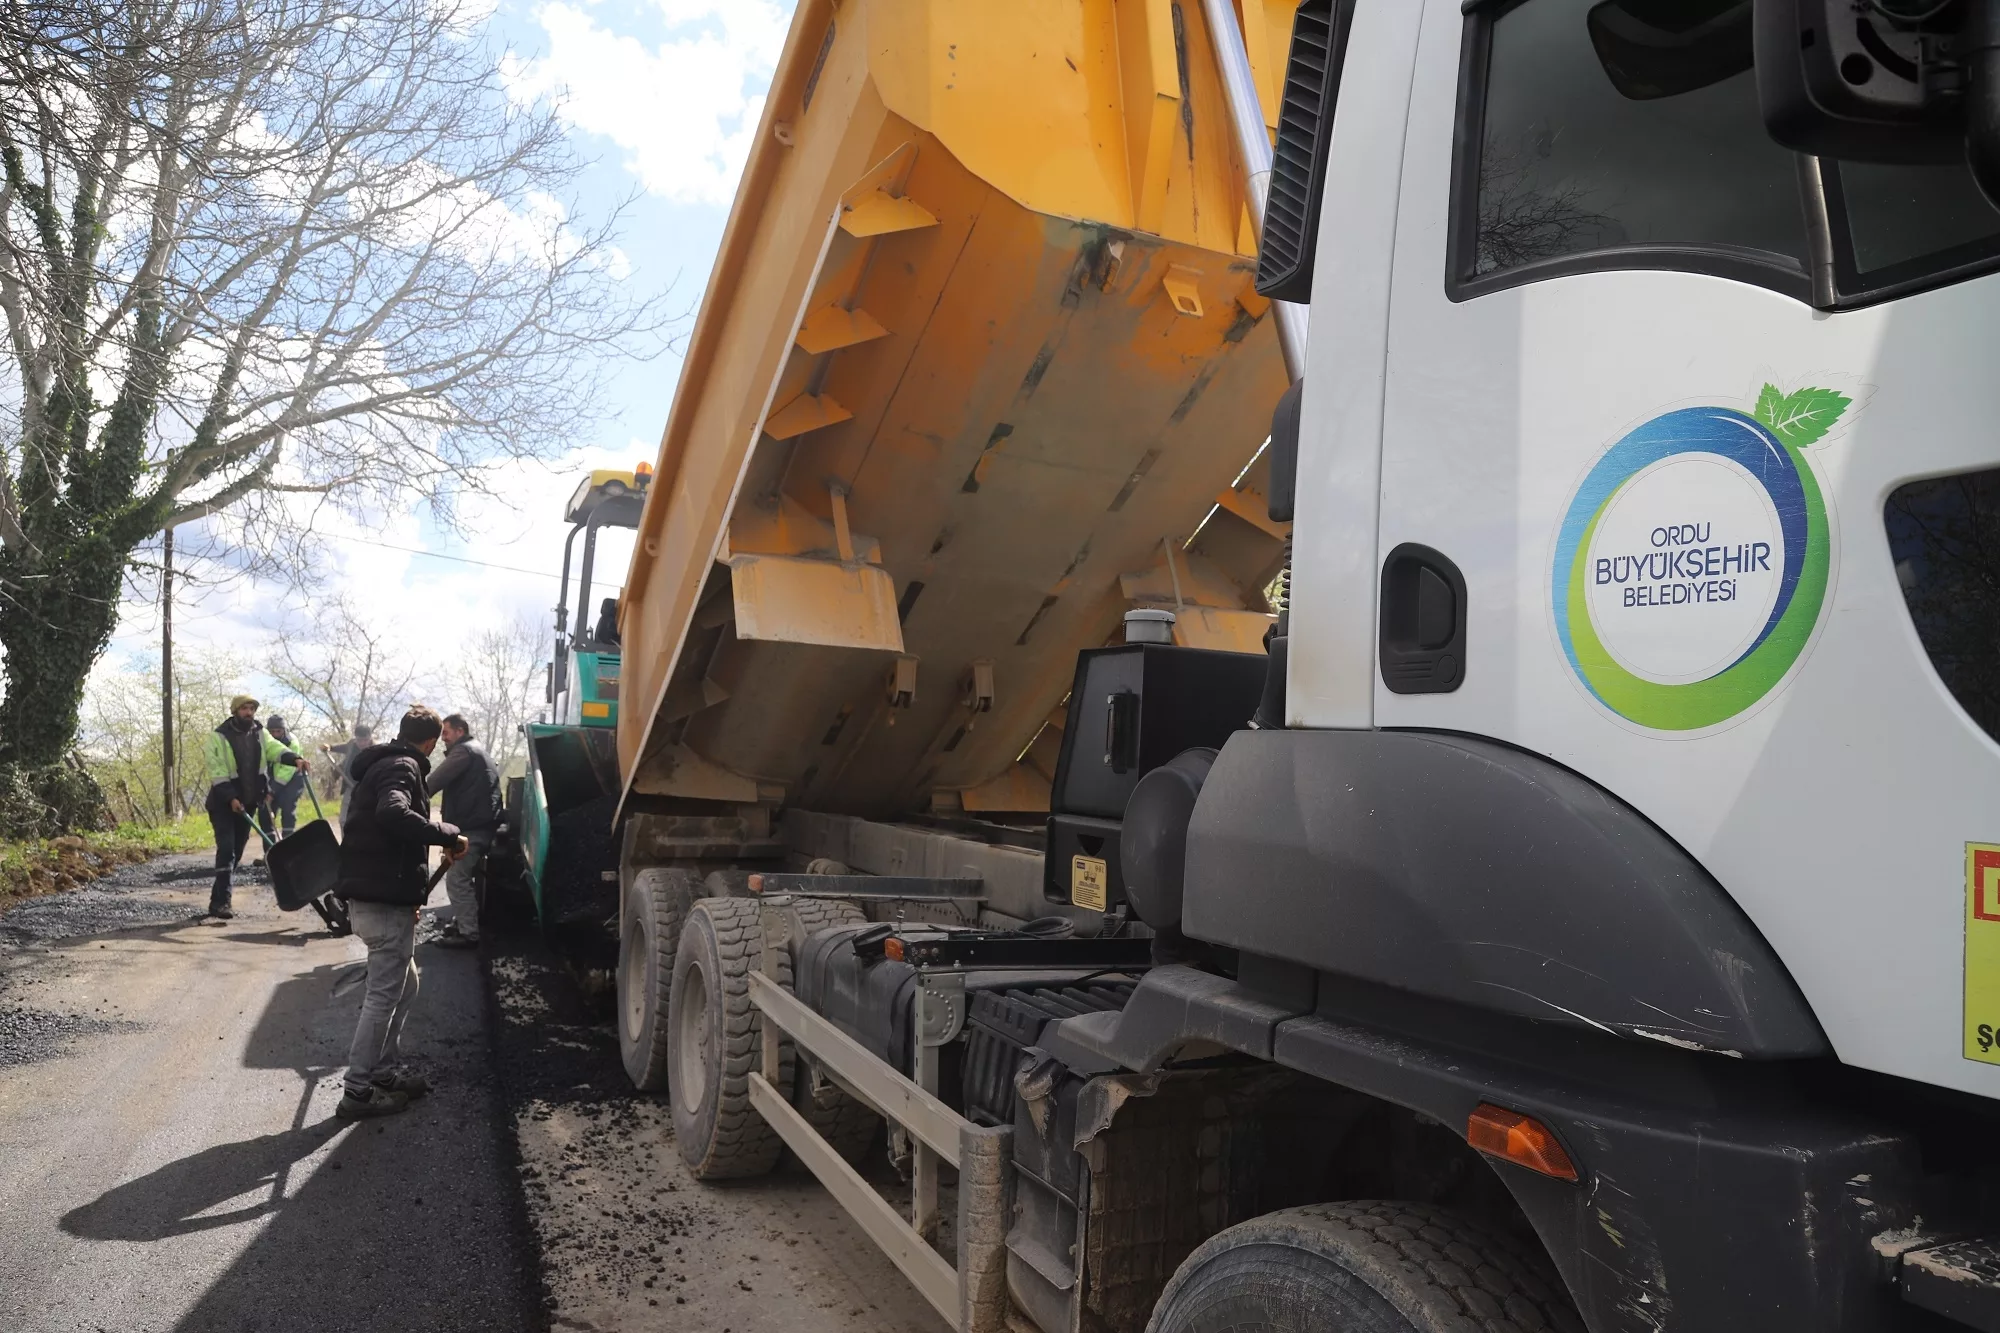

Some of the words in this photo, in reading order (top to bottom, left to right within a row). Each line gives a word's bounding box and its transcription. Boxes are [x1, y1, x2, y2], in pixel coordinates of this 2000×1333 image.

[1650, 522, 1711, 548] ORDU
[1595, 542, 1771, 585] BÜYÜKŞEHİR
[1623, 579, 1737, 607] BELEDİYESİ
